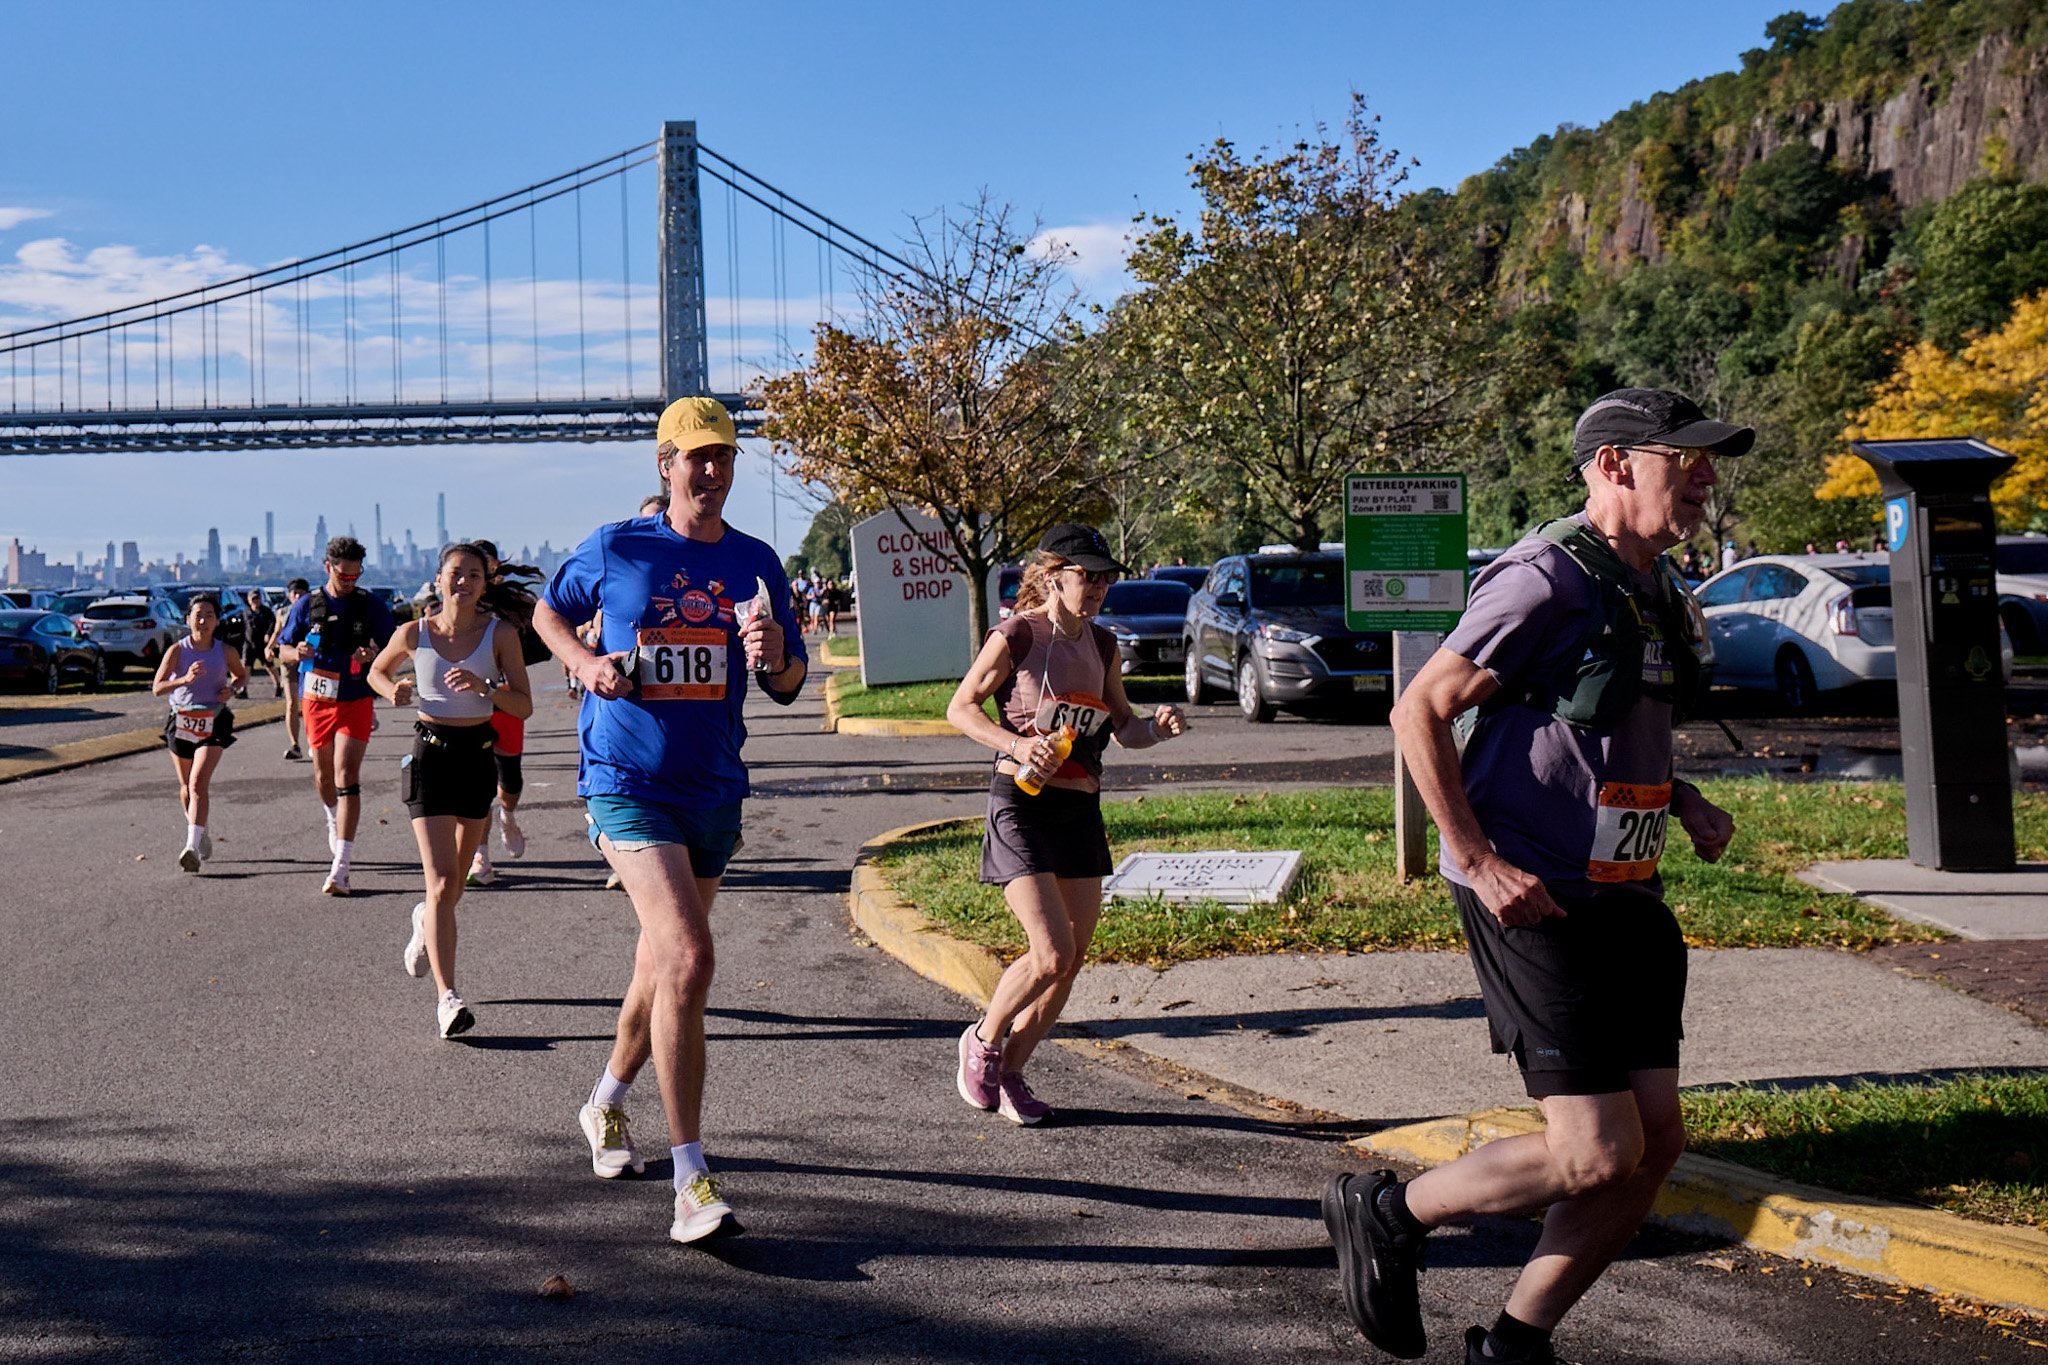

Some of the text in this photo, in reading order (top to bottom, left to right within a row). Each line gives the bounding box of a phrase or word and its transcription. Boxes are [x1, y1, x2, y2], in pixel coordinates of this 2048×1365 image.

[1352, 480, 1458, 490] METERED PARKING
[1352, 495, 1417, 504] PAY BY PLATE
[1352, 505, 1374, 513] Zone
[1889, 504, 1904, 542] P
[892, 558, 904, 578] &
[903, 579, 953, 600] DROP
[655, 647, 712, 683] 618
[312, 678, 327, 695] 45
[183, 717, 206, 732] 379
[1050, 703, 1095, 736] 619
[1613, 808, 1666, 861] 209
